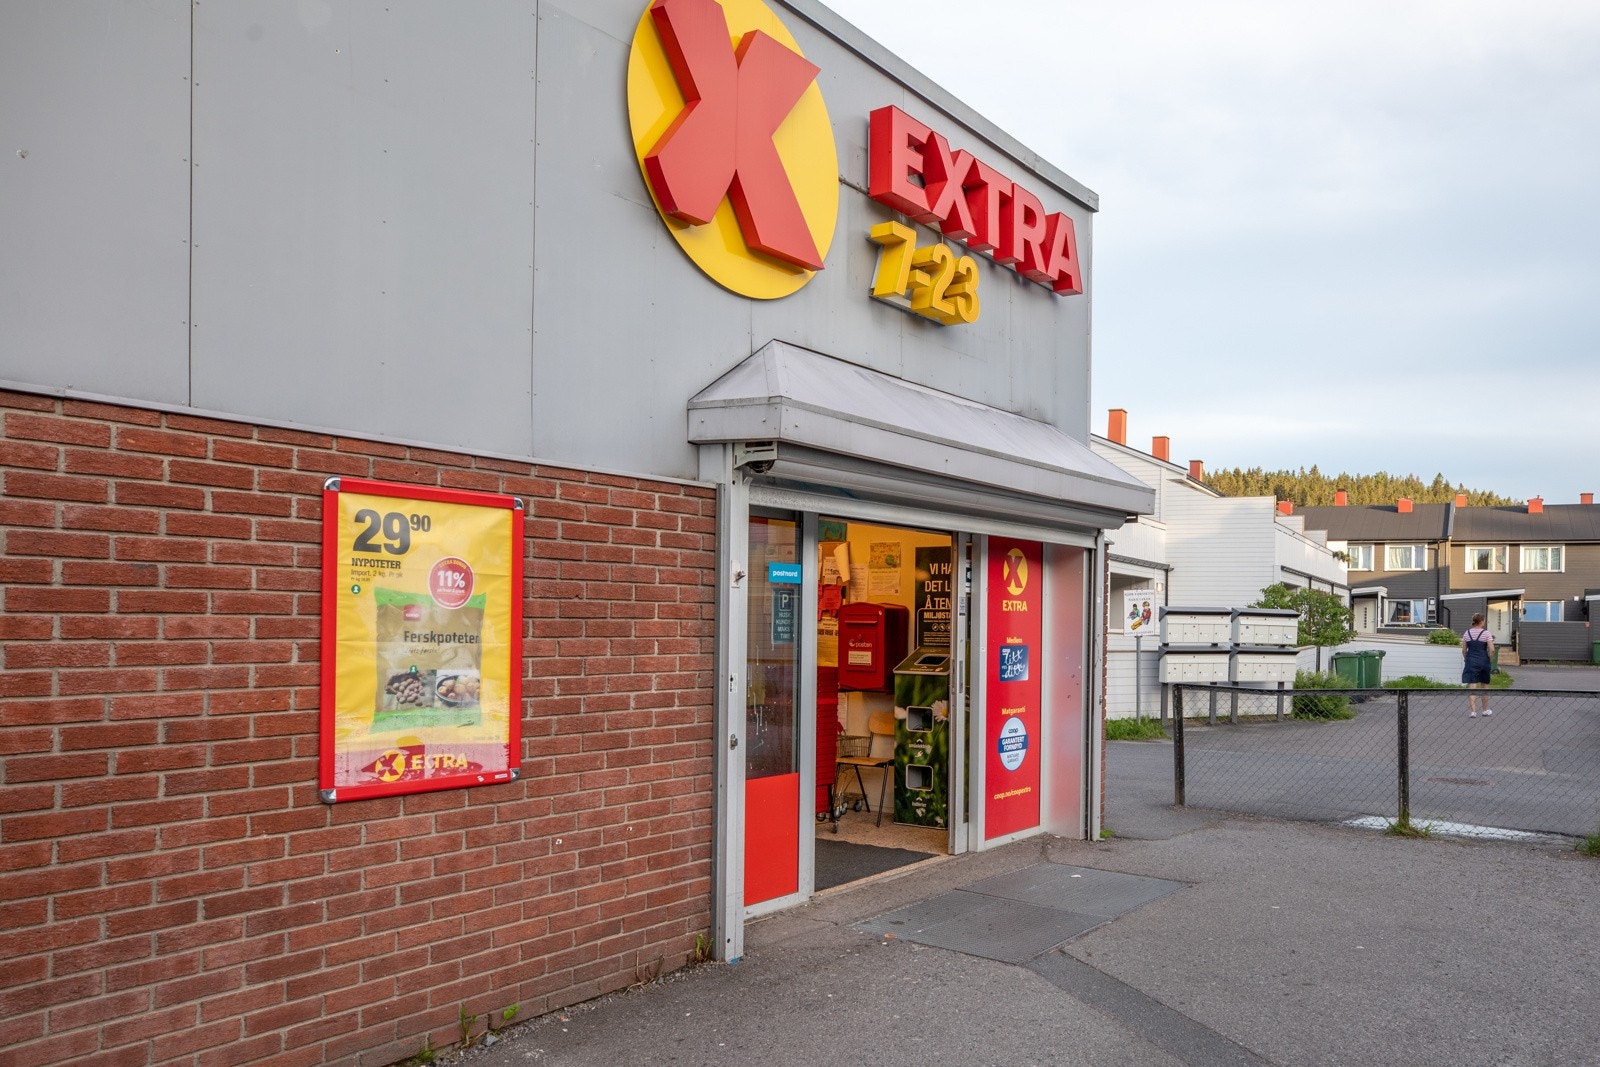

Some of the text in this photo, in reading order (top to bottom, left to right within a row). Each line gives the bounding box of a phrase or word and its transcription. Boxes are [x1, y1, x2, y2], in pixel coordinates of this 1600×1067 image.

[869, 104, 1084, 297] EXTRA
[870, 220, 981, 326] 7-23
[352, 508, 431, 556] 29 90
[351, 557, 401, 570] NYPOTETER
[929, 562, 939, 575] VI
[437, 570, 466, 588] 11%
[772, 570, 798, 578] postnord
[924, 580, 943, 592] DET
[924, 594, 932, 610] Å
[1002, 600, 1028, 612] EXTRA
[403, 630, 480, 646] Ferskpoteter
